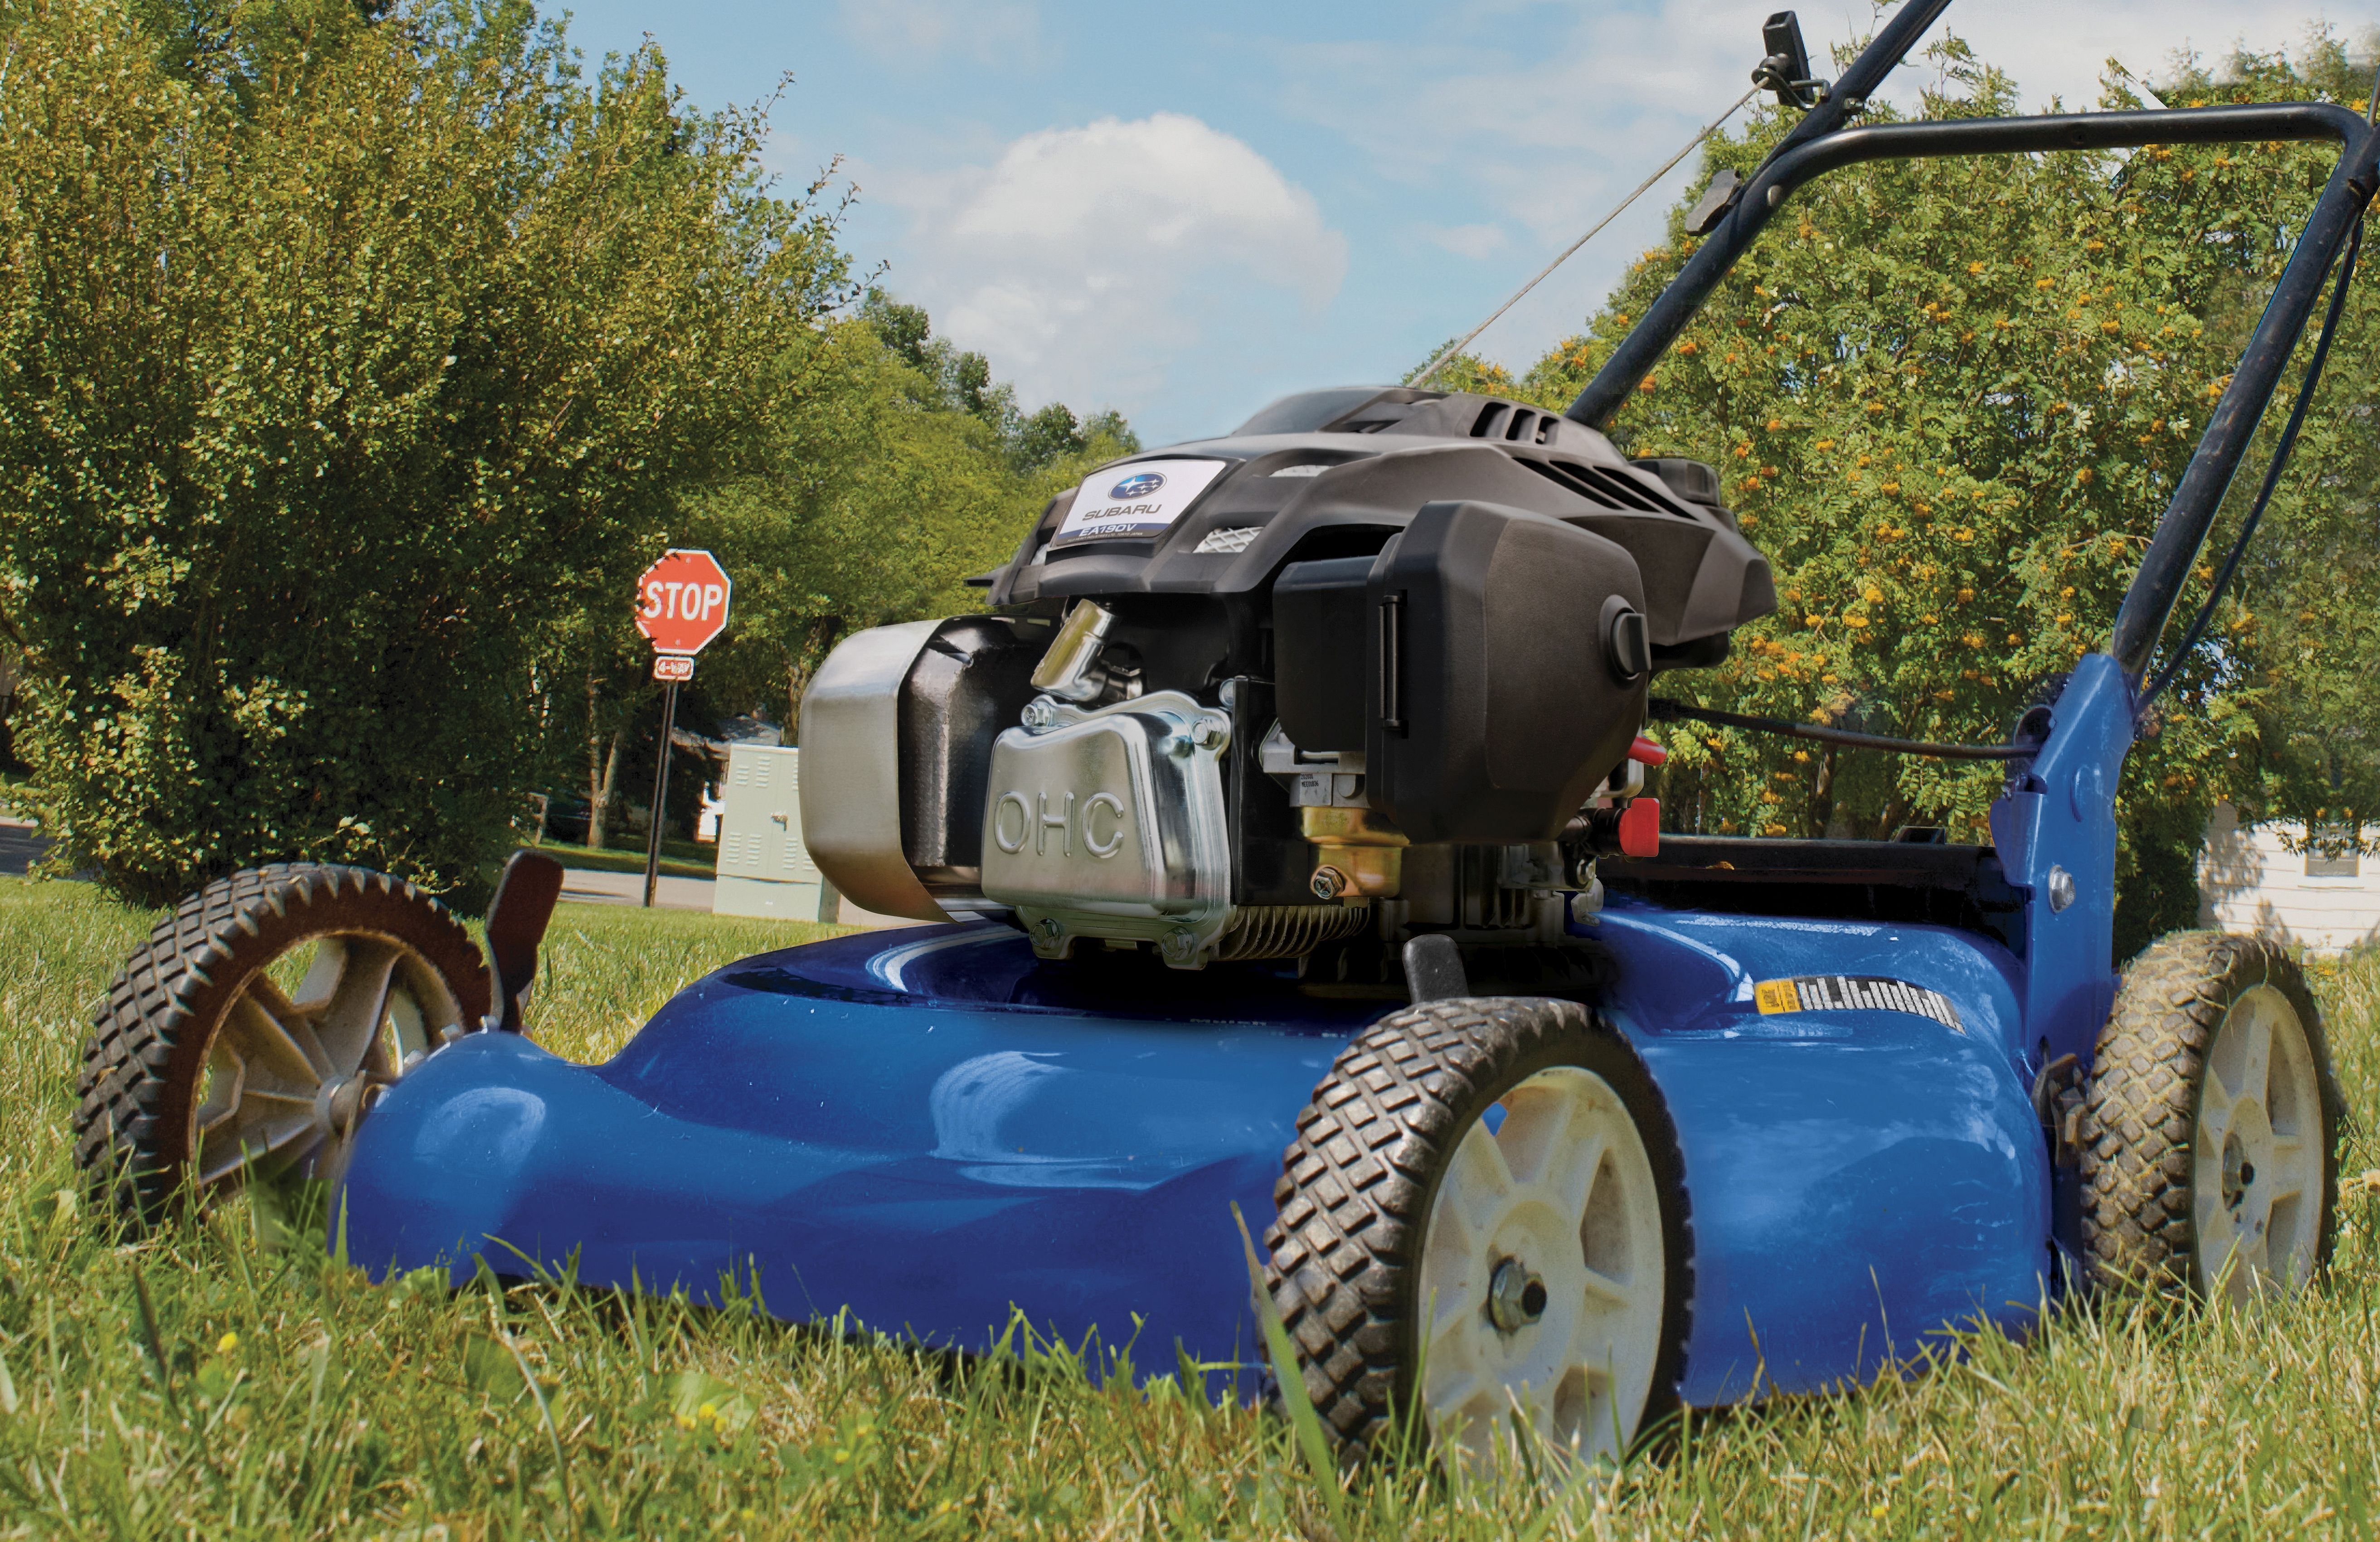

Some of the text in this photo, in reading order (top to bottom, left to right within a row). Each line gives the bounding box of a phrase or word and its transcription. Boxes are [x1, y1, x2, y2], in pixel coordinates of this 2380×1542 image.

[1082, 504, 1162, 521] SUBARU
[1078, 524, 1137, 537] EA190V
[643, 580, 723, 621] STOP
[994, 790, 1125, 859] OHC
